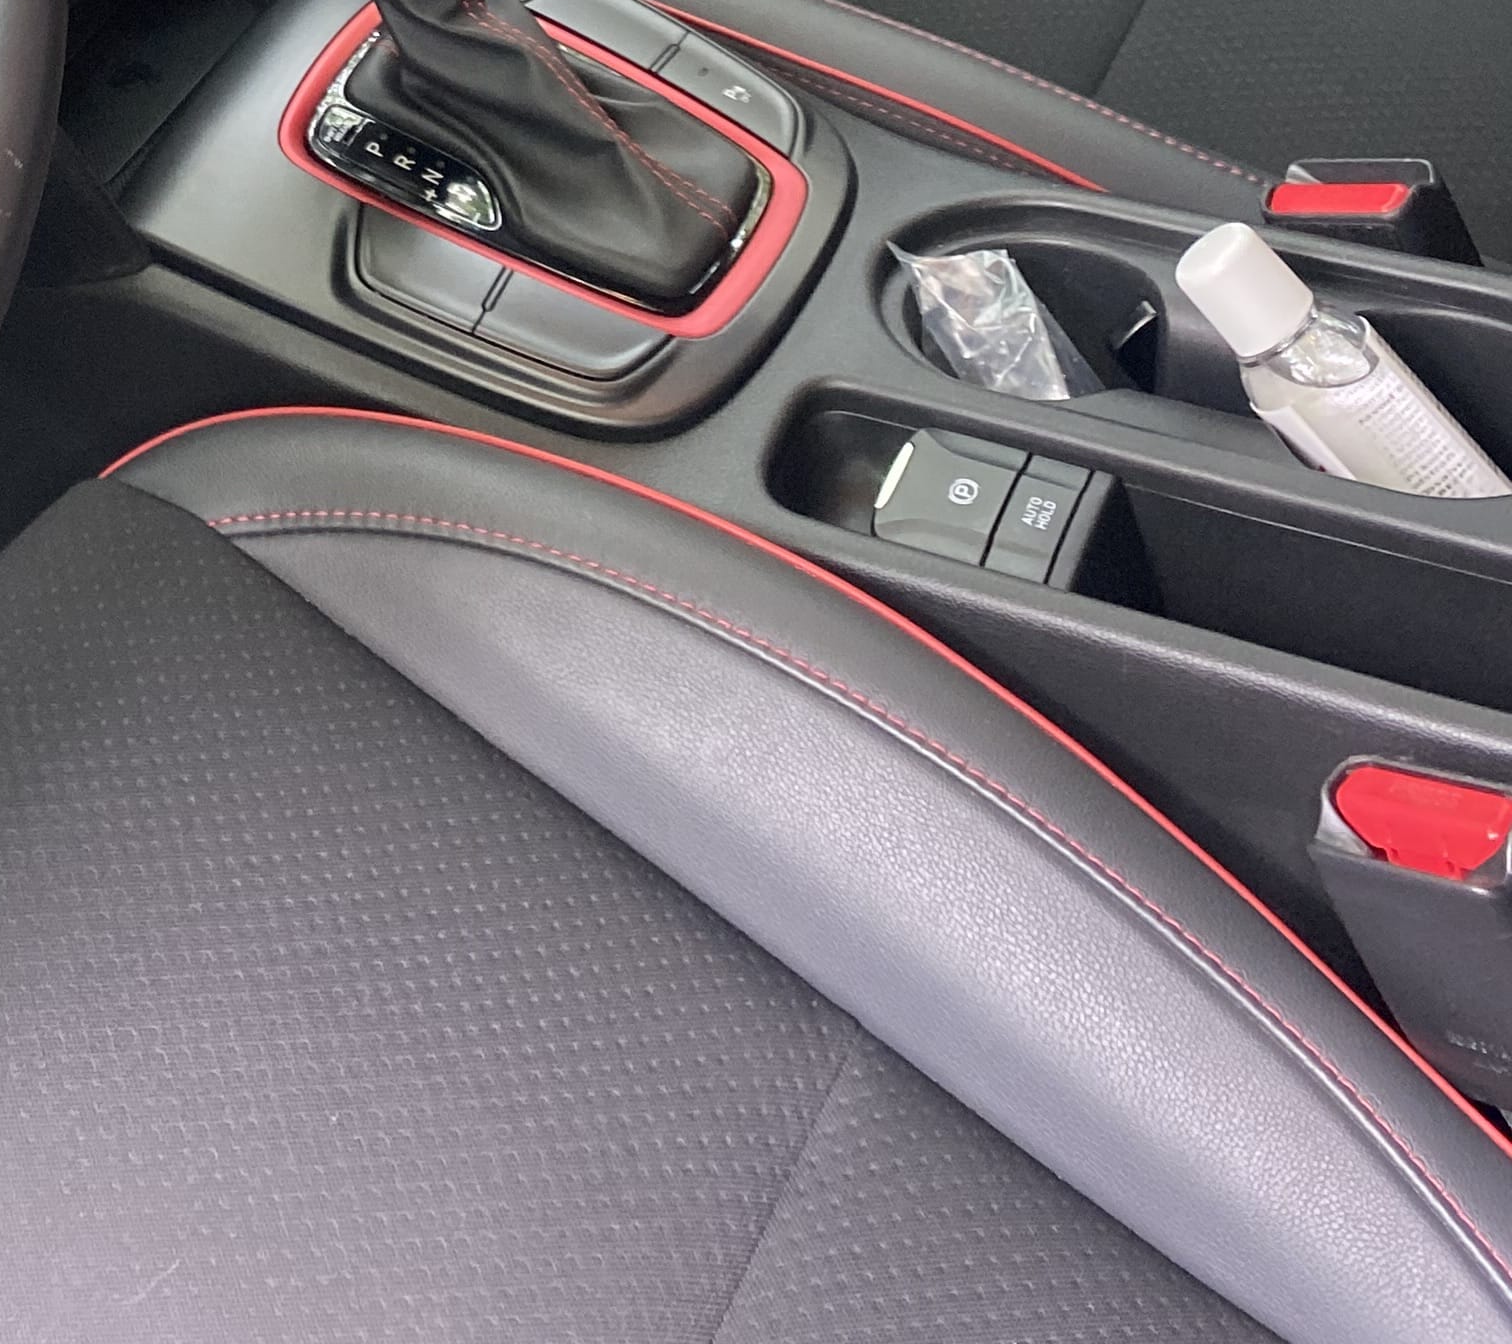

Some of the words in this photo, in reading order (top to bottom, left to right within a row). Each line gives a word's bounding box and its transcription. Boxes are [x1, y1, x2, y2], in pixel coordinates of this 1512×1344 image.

[365, 141, 384, 159] P
[393, 153, 417, 172] R
[421, 166, 445, 187] N
[1021, 496, 1044, 527] AUTO
[1034, 499, 1058, 531] HOLD
